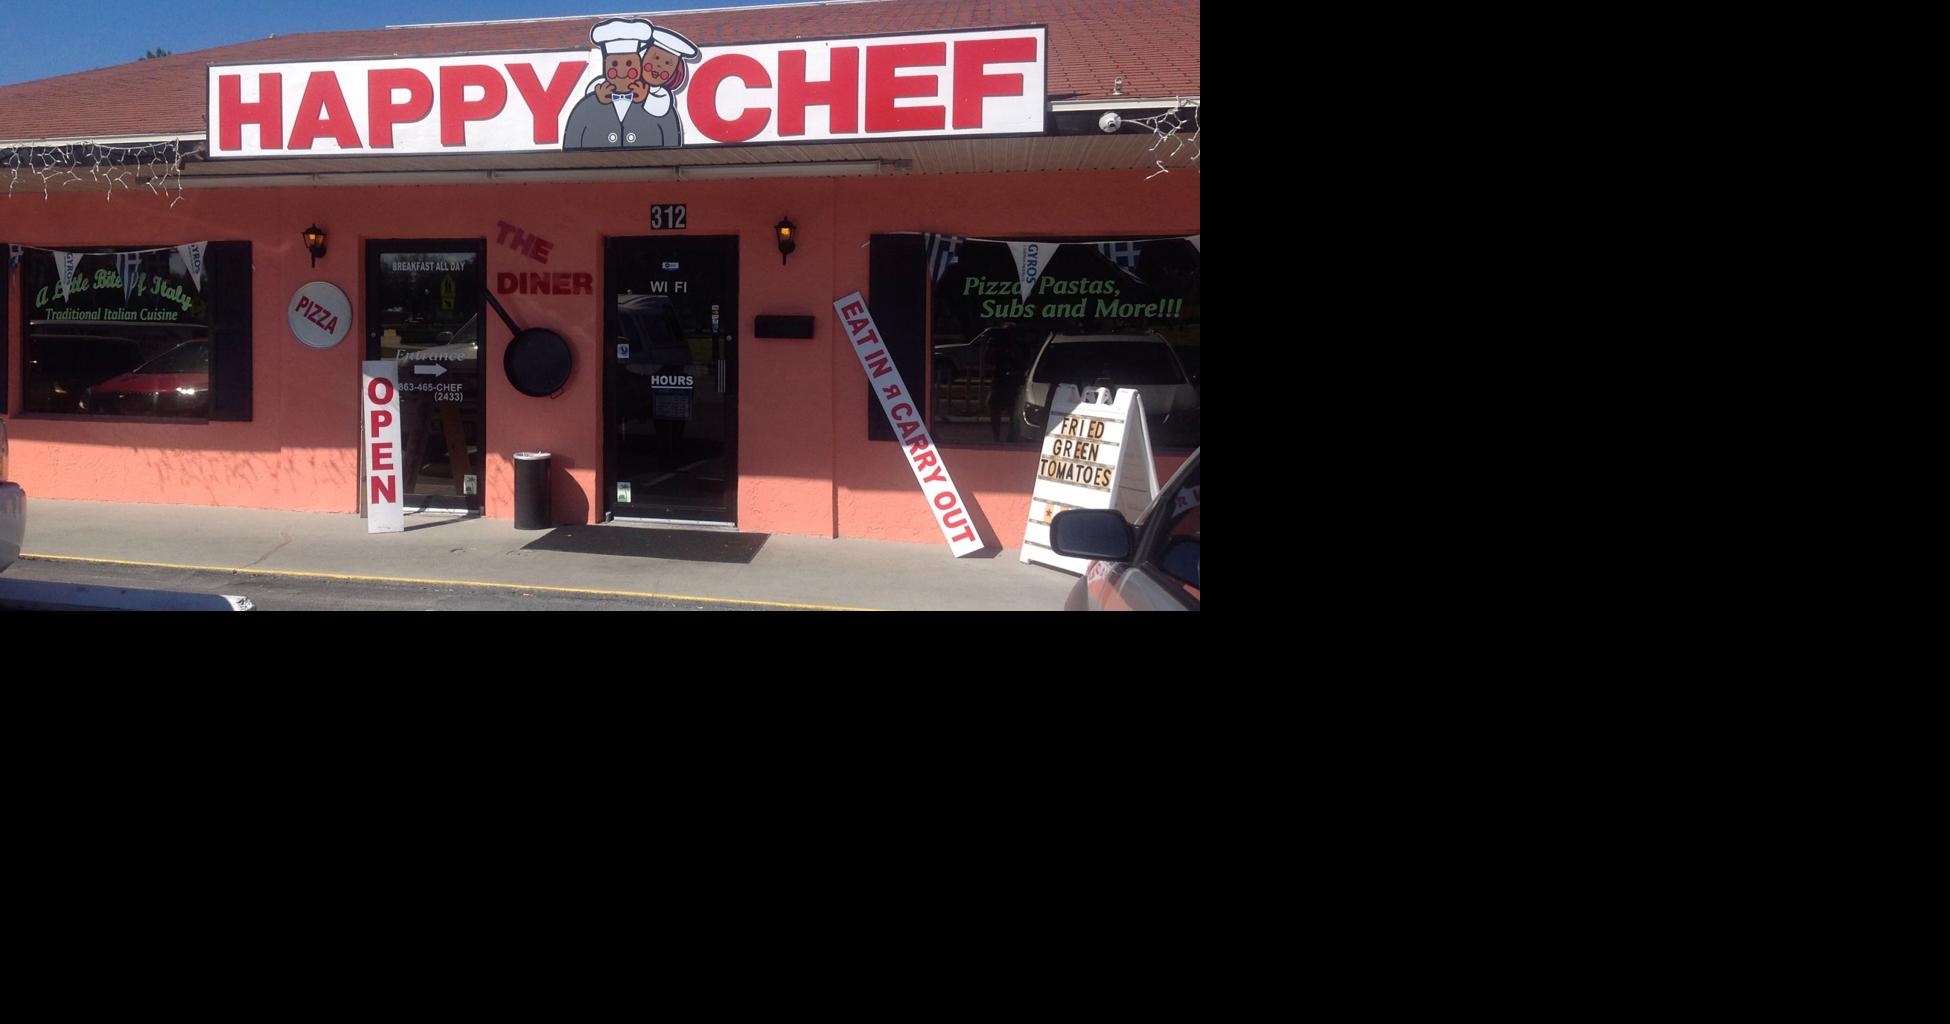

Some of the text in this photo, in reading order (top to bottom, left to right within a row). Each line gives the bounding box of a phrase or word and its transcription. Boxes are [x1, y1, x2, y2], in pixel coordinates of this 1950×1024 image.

[218, 36, 1037, 151] HAPPY CHEF
[651, 205, 686, 229] 312
[496, 220, 554, 264] THE
[192, 244, 201, 274] YROS
[392, 261, 465, 272] BREAKFAST ALL DAY
[1026, 243, 1039, 284] GYROS
[35, 286, 49, 308] A
[52, 272, 90, 300] Lttle
[93, 268, 123, 289] Bite
[151, 275, 193, 311] Italy
[496, 272, 593, 295] DINER
[650, 281, 687, 293] WI FI
[1038, 276, 1121, 297] Pastas,
[45, 307, 178, 321] Traditional Italian Cuisine
[295, 295, 339, 335] PIZZA
[980, 298, 1184, 319] Subs and More!!!
[396, 349, 465, 361] Entrance
[651, 375, 694, 386] HOURS
[434, 392, 464, 402] (2433)
[841, 301, 879, 346] EAT
[864, 349, 893, 380] IN
[891, 402, 947, 484] CARRY
[933, 491, 976, 543] OUT
[1060, 417, 1105, 439] FRIED
[367, 376, 397, 505] OPEN
[1052, 438, 1100, 462] GREEN
[1040, 458, 1112, 487] TOMATOES
